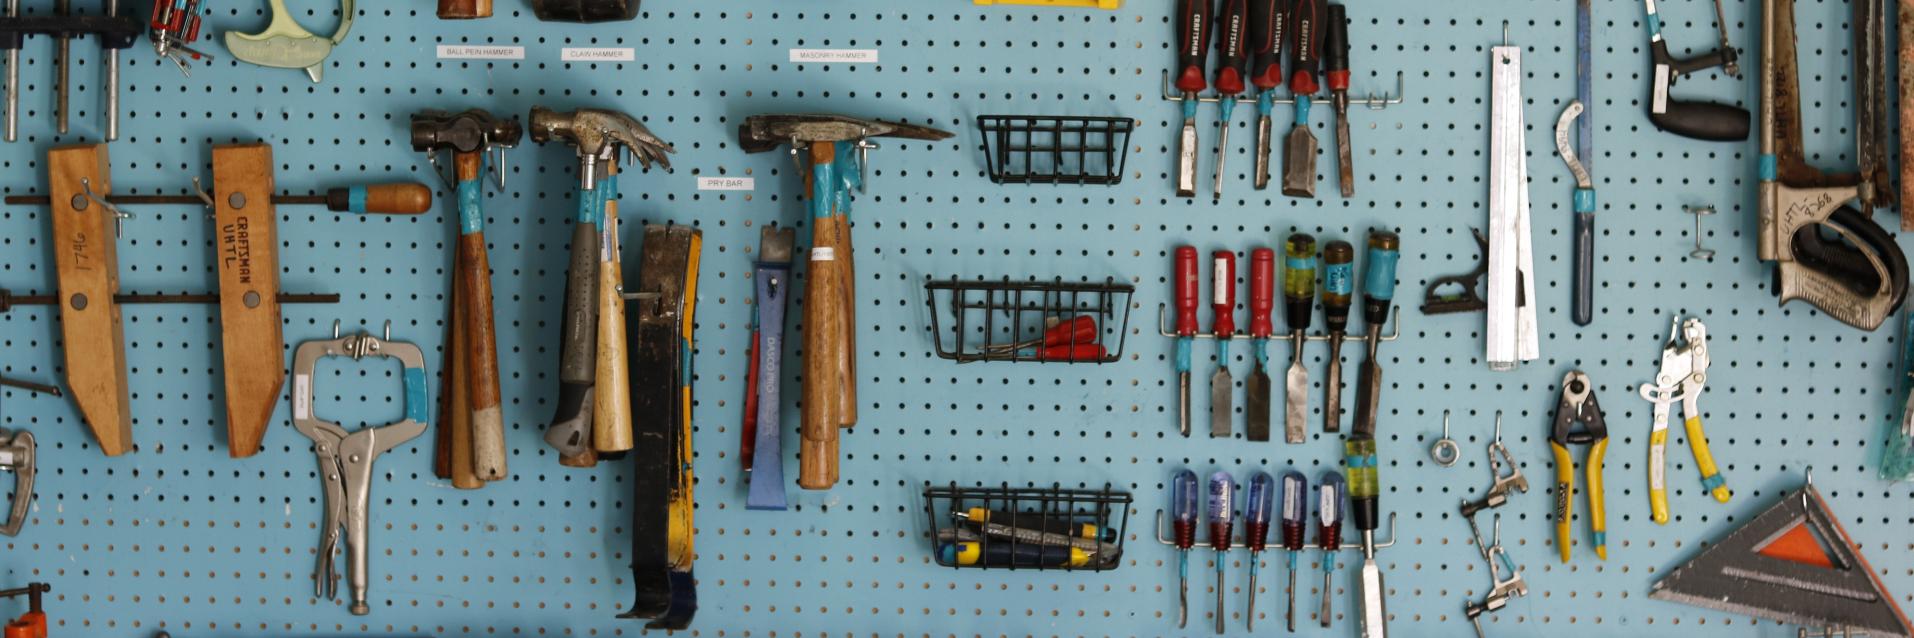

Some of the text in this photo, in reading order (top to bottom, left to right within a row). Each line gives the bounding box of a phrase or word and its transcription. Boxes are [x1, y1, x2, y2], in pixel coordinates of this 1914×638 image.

[465, 48, 482, 56] PEIN
[483, 48, 514, 56] HAMMER
[1191, 14, 1201, 56] CRAFTSMAN
[1229, 15, 1239, 56] CRAFTSMAN
[1274, 13, 1282, 53] CRAFTSMAN
[1300, 20, 1309, 61] CRAFTSMAN
[707, 179, 743, 187] PRY BAR
[223, 224, 237, 269] UHTL
[237, 216, 250, 284] CRAFTSMAN
[766, 336, 776, 371] DASCO
